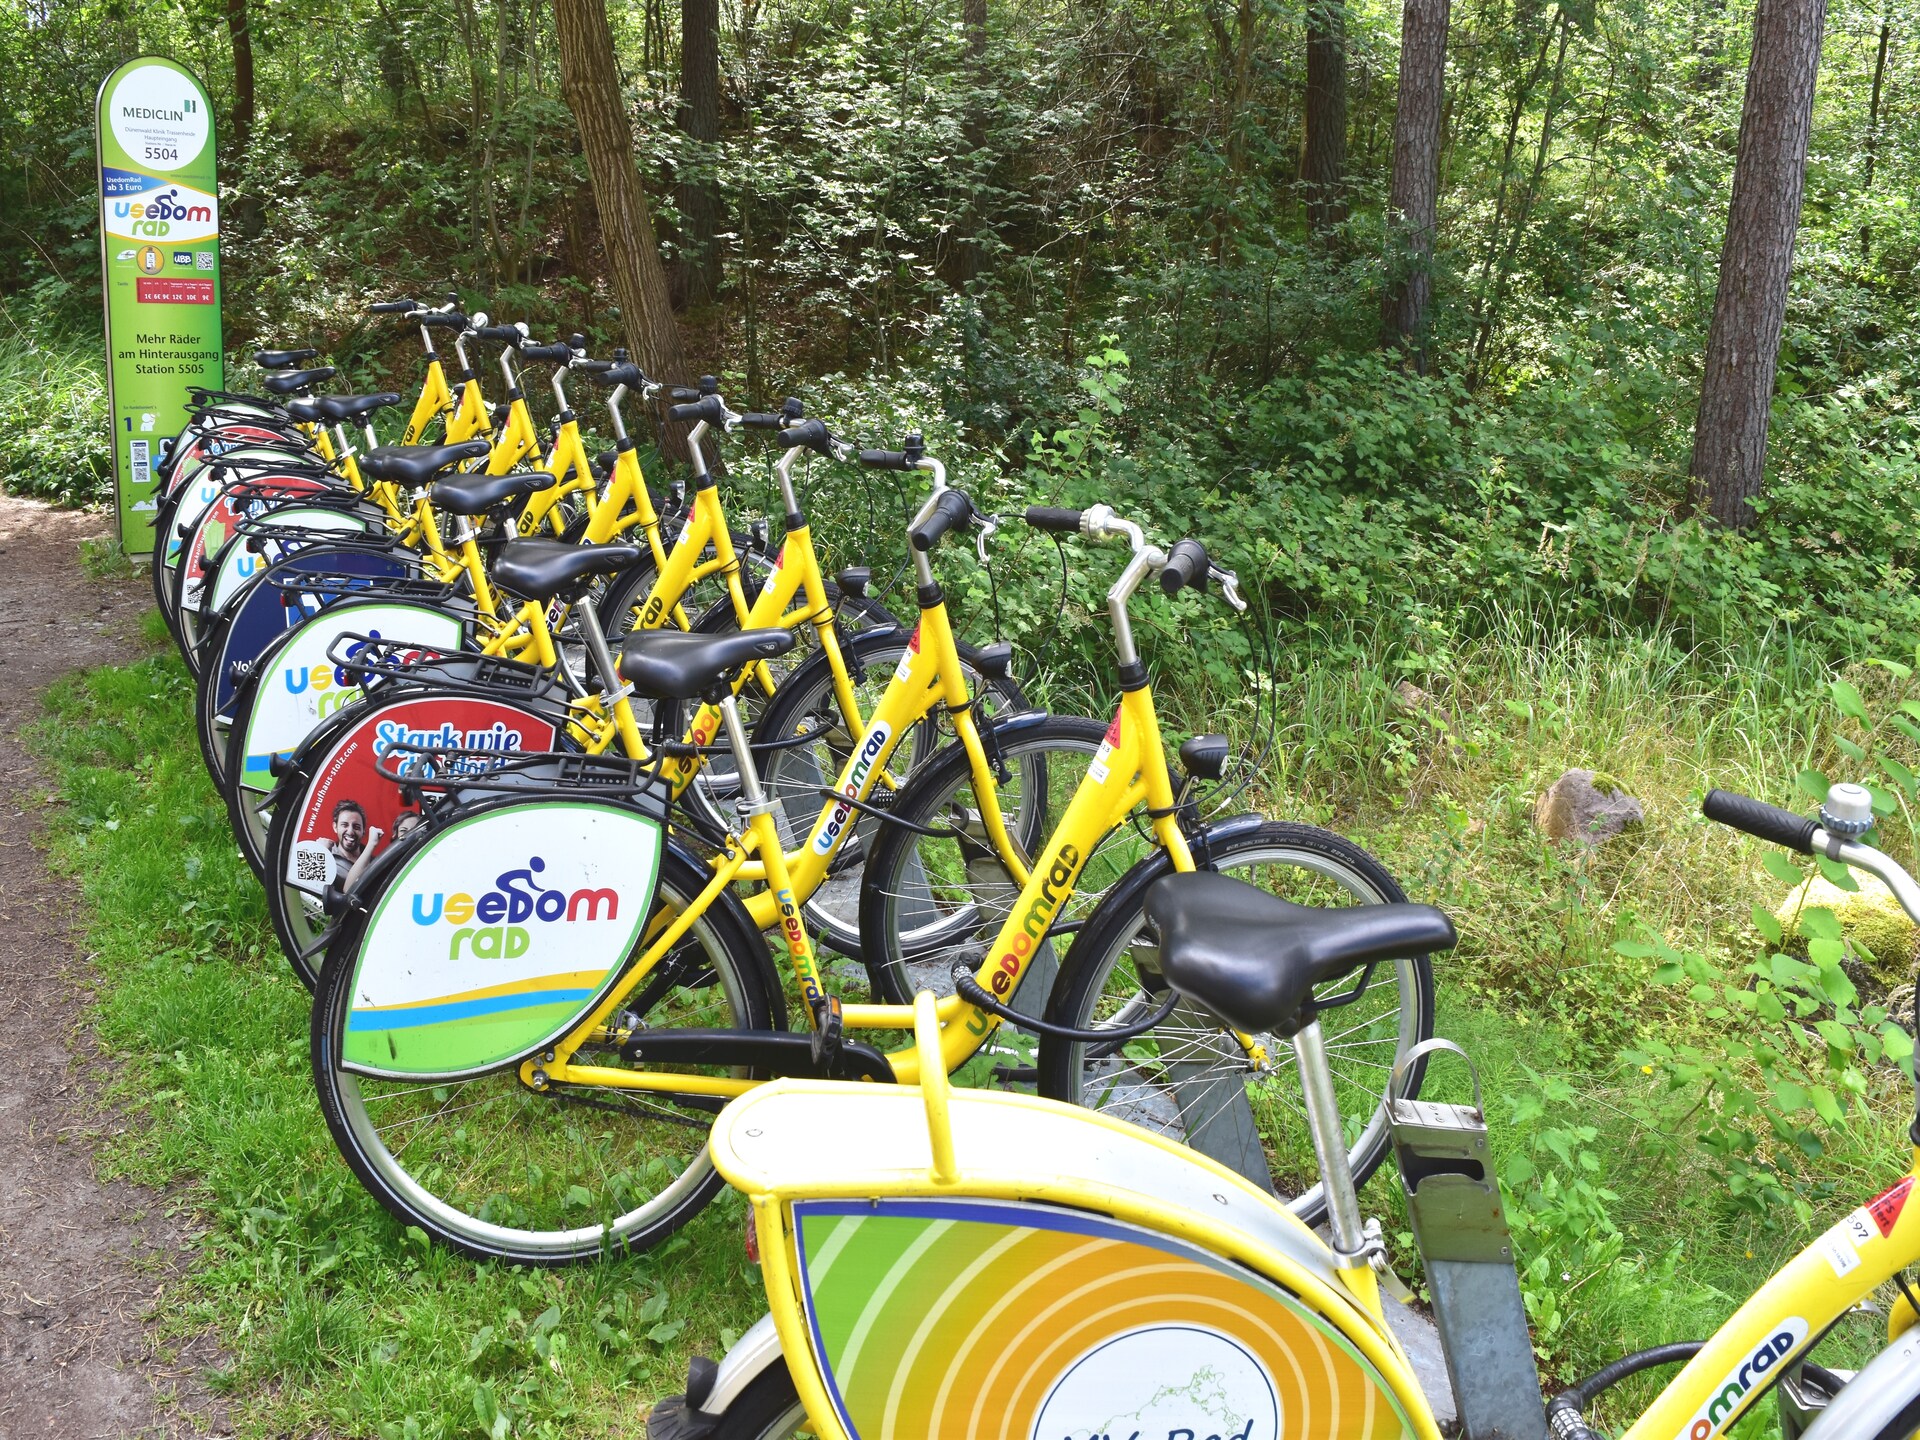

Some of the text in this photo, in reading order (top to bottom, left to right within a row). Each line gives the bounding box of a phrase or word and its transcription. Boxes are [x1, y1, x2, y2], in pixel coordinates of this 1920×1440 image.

[123, 106, 183, 122] MEDICLIN
[144, 134, 177, 142] Haupteingang
[145, 147, 178, 160] 5504
[136, 334, 201, 344] Mehr Räder
[119, 350, 219, 361] am Hinterausgang
[136, 364, 204, 374] Station 5505
[124, 417, 132, 432] 1
[376, 722, 463, 756] Stark
[306, 742, 358, 833] www.kaufhaus-stolz.com
